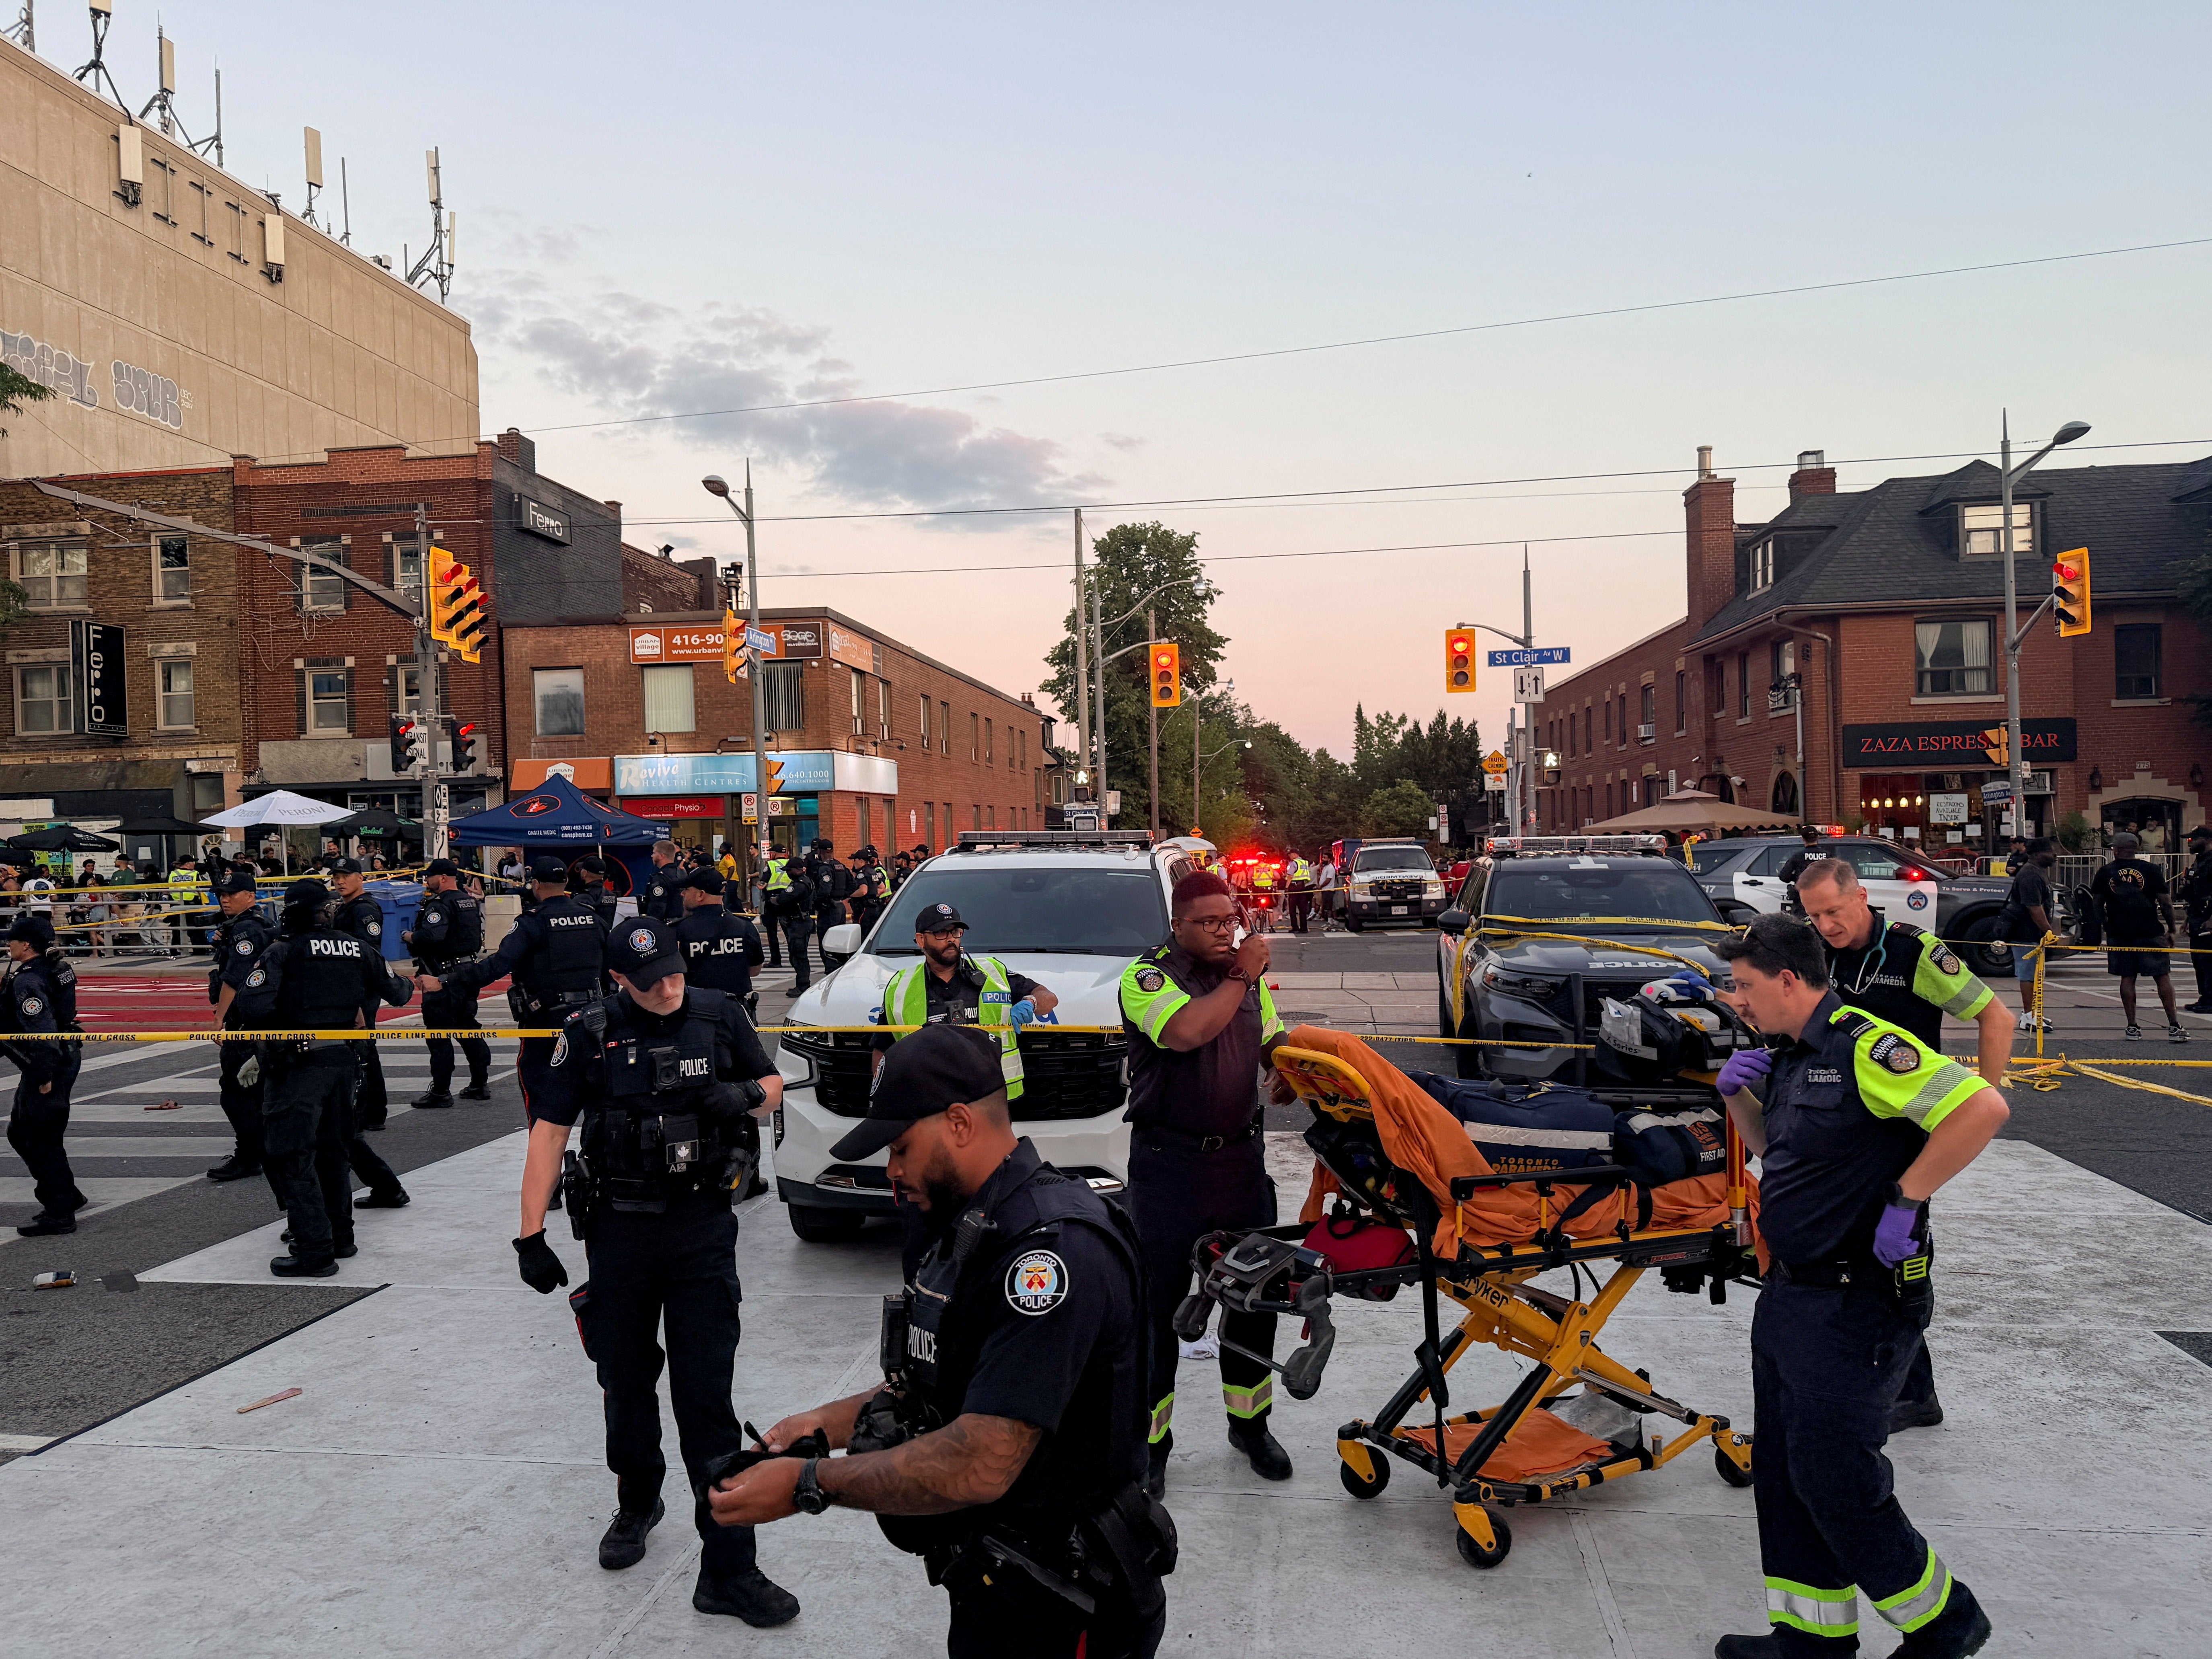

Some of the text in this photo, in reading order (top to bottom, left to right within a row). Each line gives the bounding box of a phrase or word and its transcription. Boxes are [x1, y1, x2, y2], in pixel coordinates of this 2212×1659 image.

[529, 501, 562, 536] Ferro
[749, 630, 770, 648] Arlington
[1495, 653, 1507, 664] St
[1512, 651, 1539, 663] Clair
[1553, 650, 1563, 660] W
[90, 625, 105, 722] Ferro
[1860, 733, 2060, 753] ZAZA ESPRES BAR
[408, 747, 427, 759] SIGNAL
[620, 763, 679, 789] Revive
[695, 778, 747, 786] CENTRES
[1983, 791, 2004, 800] Arlington
[278, 806, 326, 816] PERONI
[550, 915, 594, 927] POLICE
[310, 939, 361, 957] POLICE
[680, 1058, 709, 1077] POLICE
[1500, 1157, 1558, 1166] TORONTO
[1700, 1151, 1716, 1162] FIRST
[1016, 1254, 1057, 1269] TORONTO
[1020, 1295, 1053, 1309] POLICE
[908, 1324, 937, 1364] POLICE
